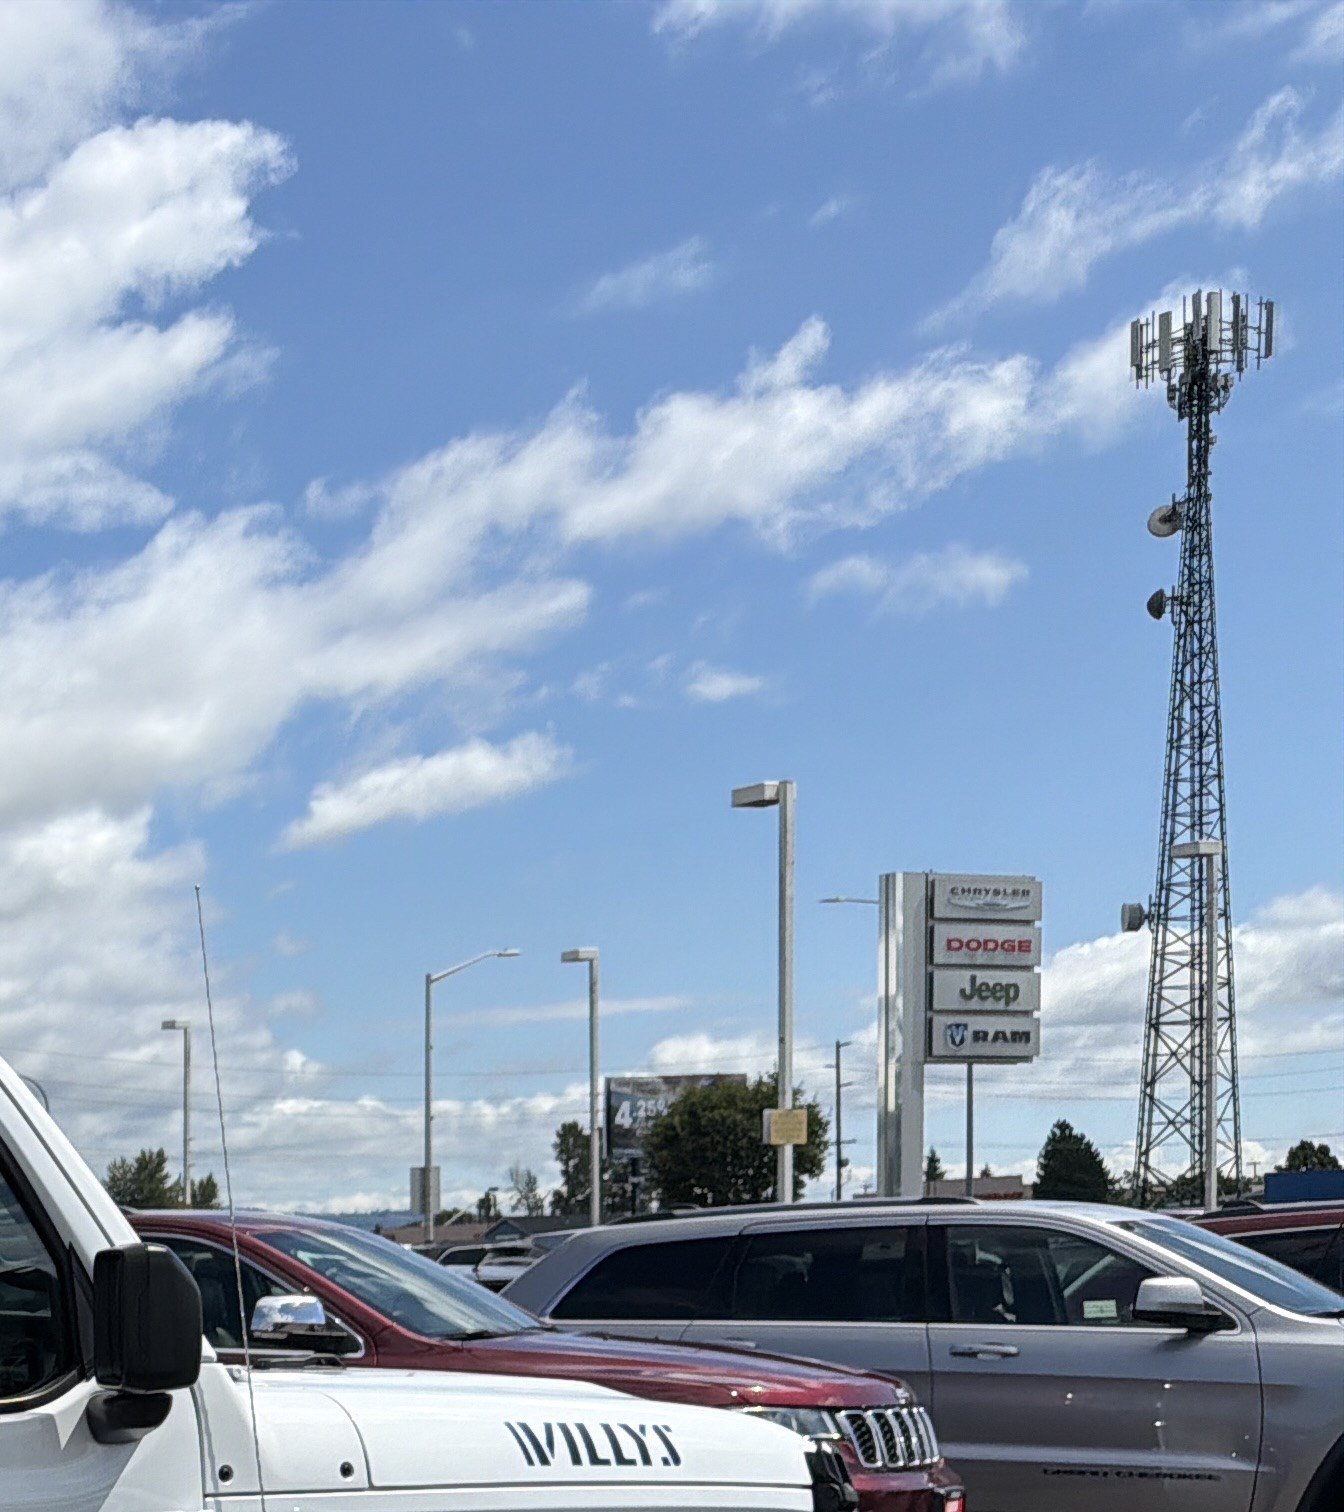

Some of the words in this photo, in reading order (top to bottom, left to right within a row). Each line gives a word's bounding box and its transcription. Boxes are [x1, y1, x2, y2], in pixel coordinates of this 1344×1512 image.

[949, 886, 1031, 897] CHRYSLER
[946, 938, 1032, 953] DODGE
[959, 974, 1020, 1007] Jeep
[971, 1029, 1031, 1044] RAM
[504, 1421, 682, 1467] WILLYS
